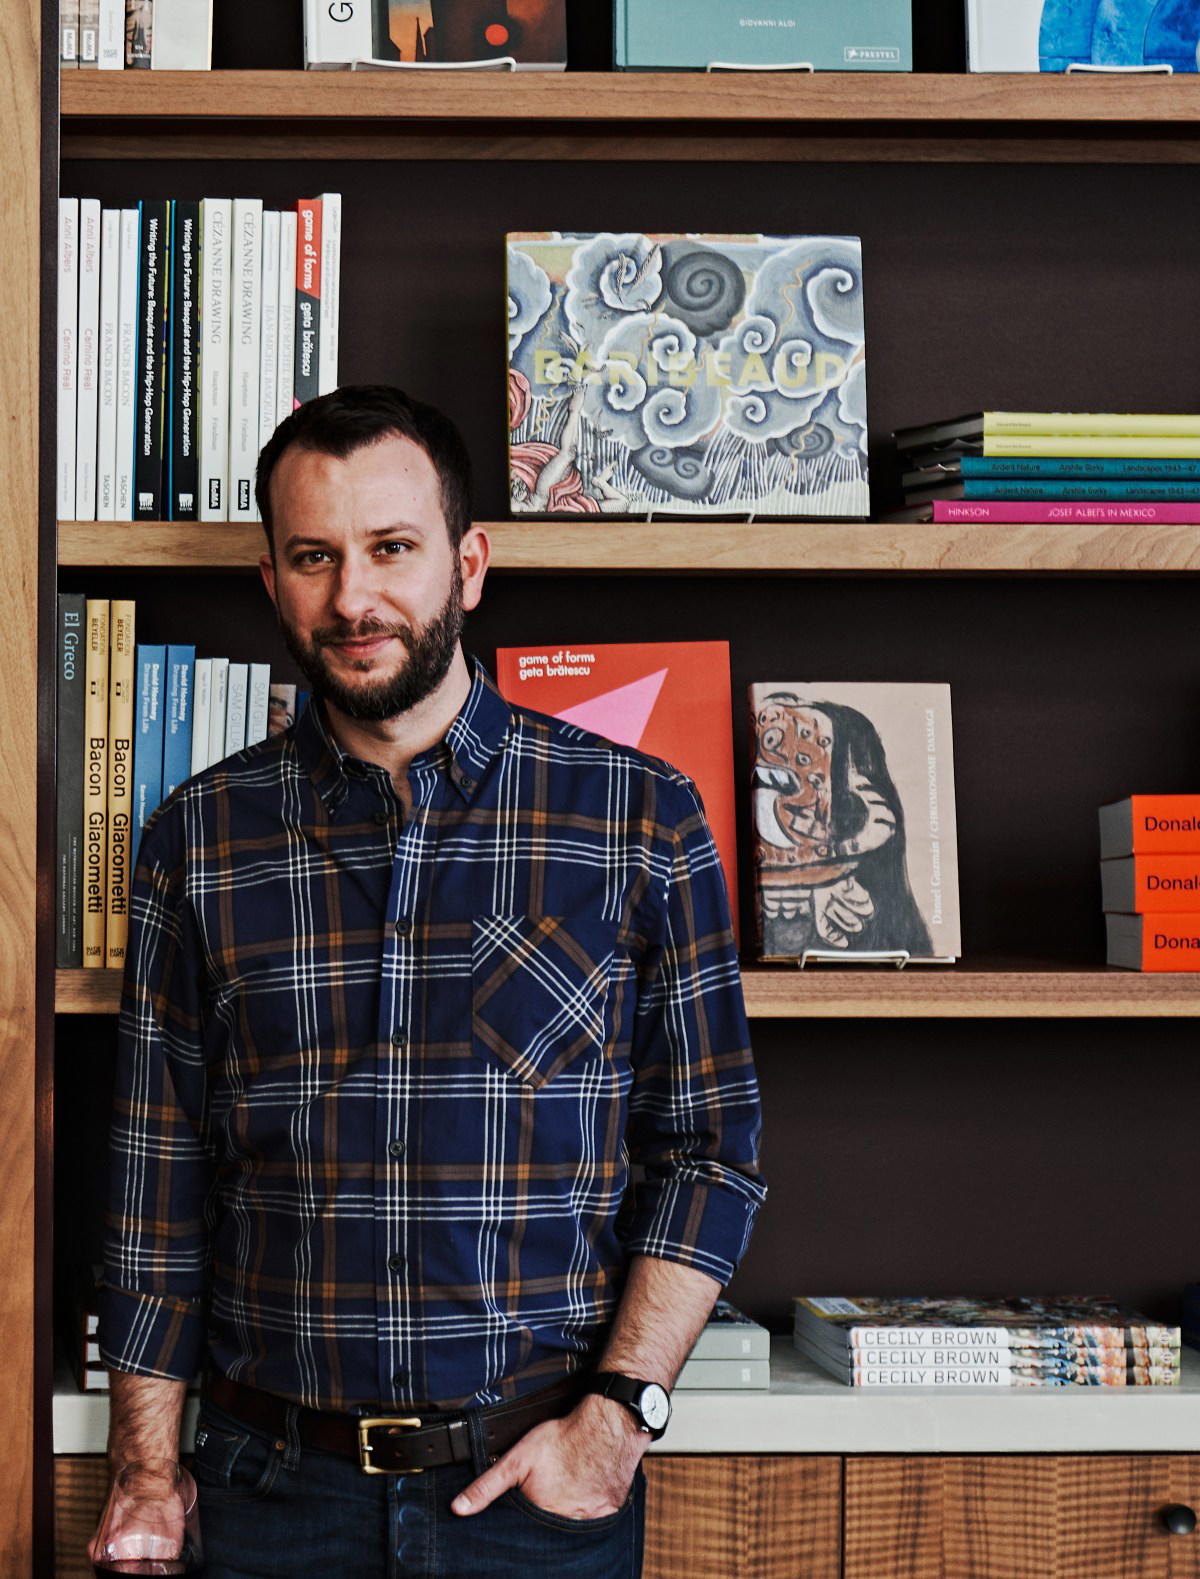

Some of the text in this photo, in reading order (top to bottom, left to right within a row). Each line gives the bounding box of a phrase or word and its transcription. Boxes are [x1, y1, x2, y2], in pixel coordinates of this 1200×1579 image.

[739, 19, 776, 27] GIOVANNI
[858, 50, 896, 59] PRESTEL
[63, 216, 73, 273] Anni Albers
[85, 216, 95, 273] Anni Albers
[303, 209, 316, 289] game of forms
[211, 210, 224, 344] CÉZANNE DRAWING
[241, 211, 256, 345] CÉZANNE DRAWING
[62, 328, 72, 391] Camino Real
[84, 328, 94, 391] Camino Real
[143, 218, 158, 456] Writing the Future: Basquiat and the Hip-Hop Generation
[180, 218, 193, 457] Writing the Future: Basquiat and the Hip-Hop Generation
[301, 302, 315, 377] geta brătescu
[104, 322, 114, 407] FRANCIS BACON
[121, 322, 132, 407] FRANCIS BACON
[103, 474, 111, 509] TASCHEN
[120, 474, 128, 509] TASCHEN
[1122, 465, 1165, 473] Landscapes
[209, 480, 220, 508] MoMA
[238, 481, 249, 509] MoMA
[948, 508, 989, 517] HINKSON
[1047, 508, 1072, 517] JOSEF
[1107, 508, 1117, 517] IN
[1119, 508, 1156, 517] MEXICO
[1126, 488, 1167, 496] Landscapes
[63, 611, 79, 680] El Greco
[124, 614, 132, 657] FONDATION
[519, 651, 595, 668] game of forms
[520, 665, 590, 681] geta brătescu
[141, 663, 151, 734] Drawing From Life
[149, 663, 160, 721] David Hockney
[170, 664, 180, 734] Drawing From Life
[178, 664, 189, 722] David Hockney
[232, 683, 244, 710] SAM
[254, 682, 266, 708] SAM
[925, 708, 936, 753] DAMAGE
[927, 755, 939, 832] CHROMOSOME
[87, 738, 106, 914] Bacon Giacometti
[110, 739, 129, 915] Bacon Giacometti
[1147, 874, 1200, 891] Donal
[930, 889, 943, 925] Daniel
[864, 1331, 998, 1345] CECILY BROWN
[865, 1350, 1000, 1364] CECILY BROWN
[865, 1370, 1000, 1384] CECILY BROWN
